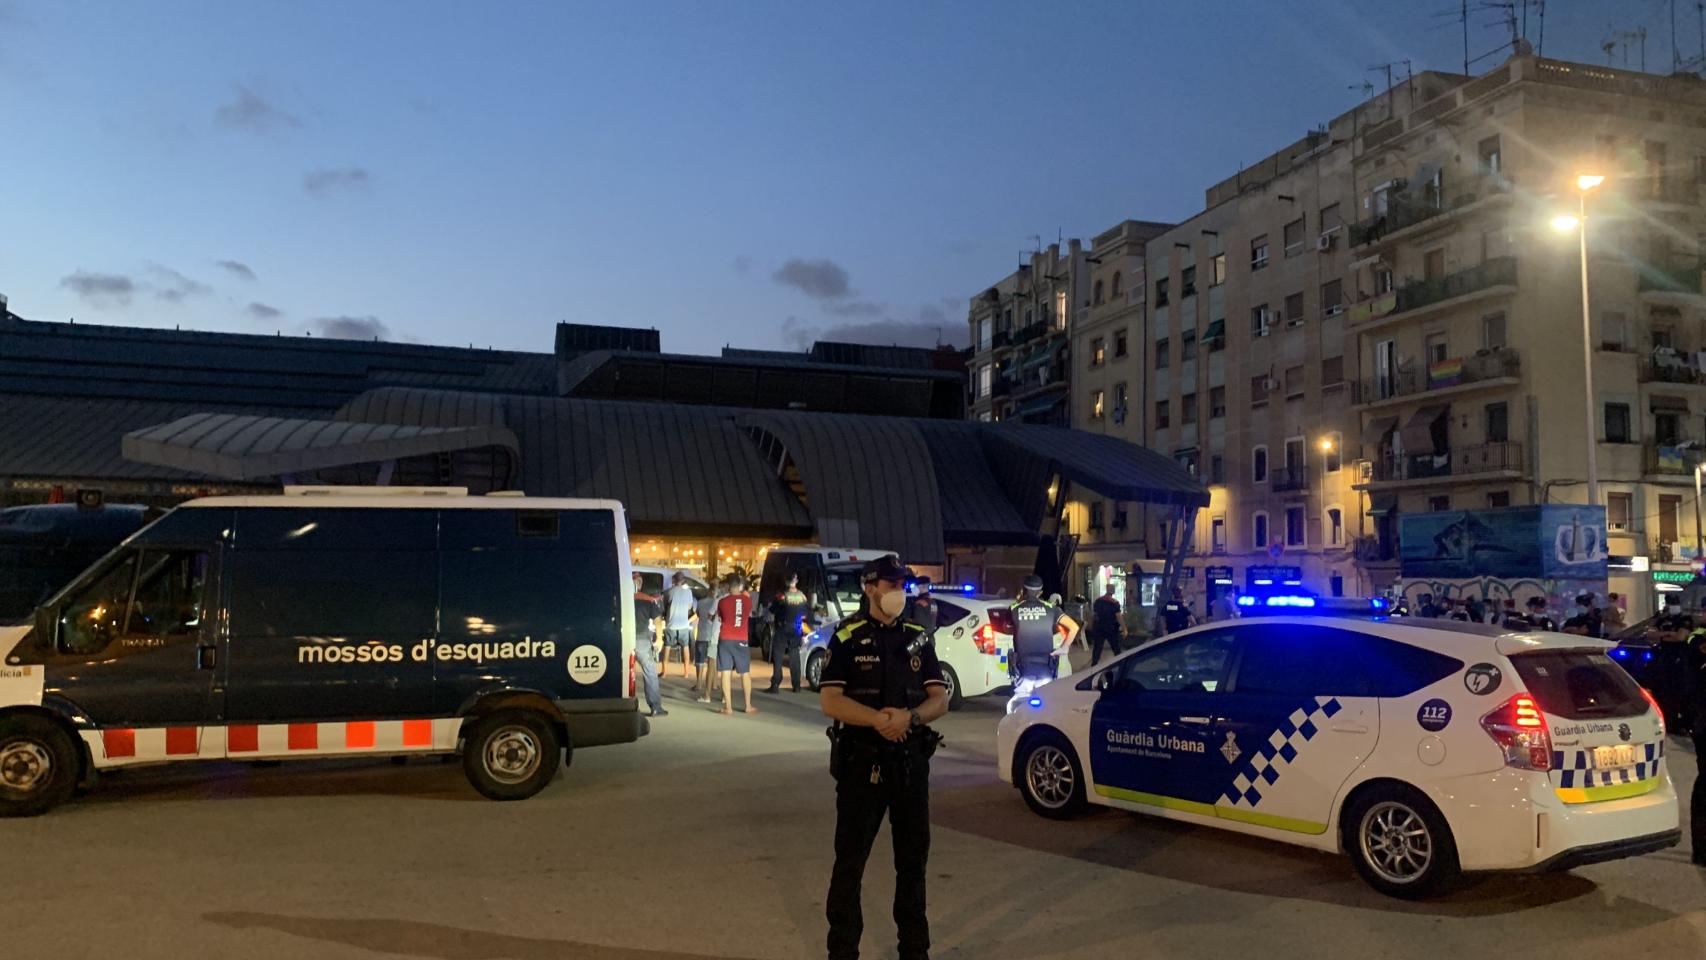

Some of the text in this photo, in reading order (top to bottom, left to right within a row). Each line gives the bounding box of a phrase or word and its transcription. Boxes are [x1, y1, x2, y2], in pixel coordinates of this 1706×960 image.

[298, 636, 556, 663] mossos d'esquadra
[574, 655, 600, 669] 112
[1422, 706, 1447, 719] 112
[1586, 722, 1614, 734] Urbana
[1106, 729, 1206, 753] Guàrdia Urbana
